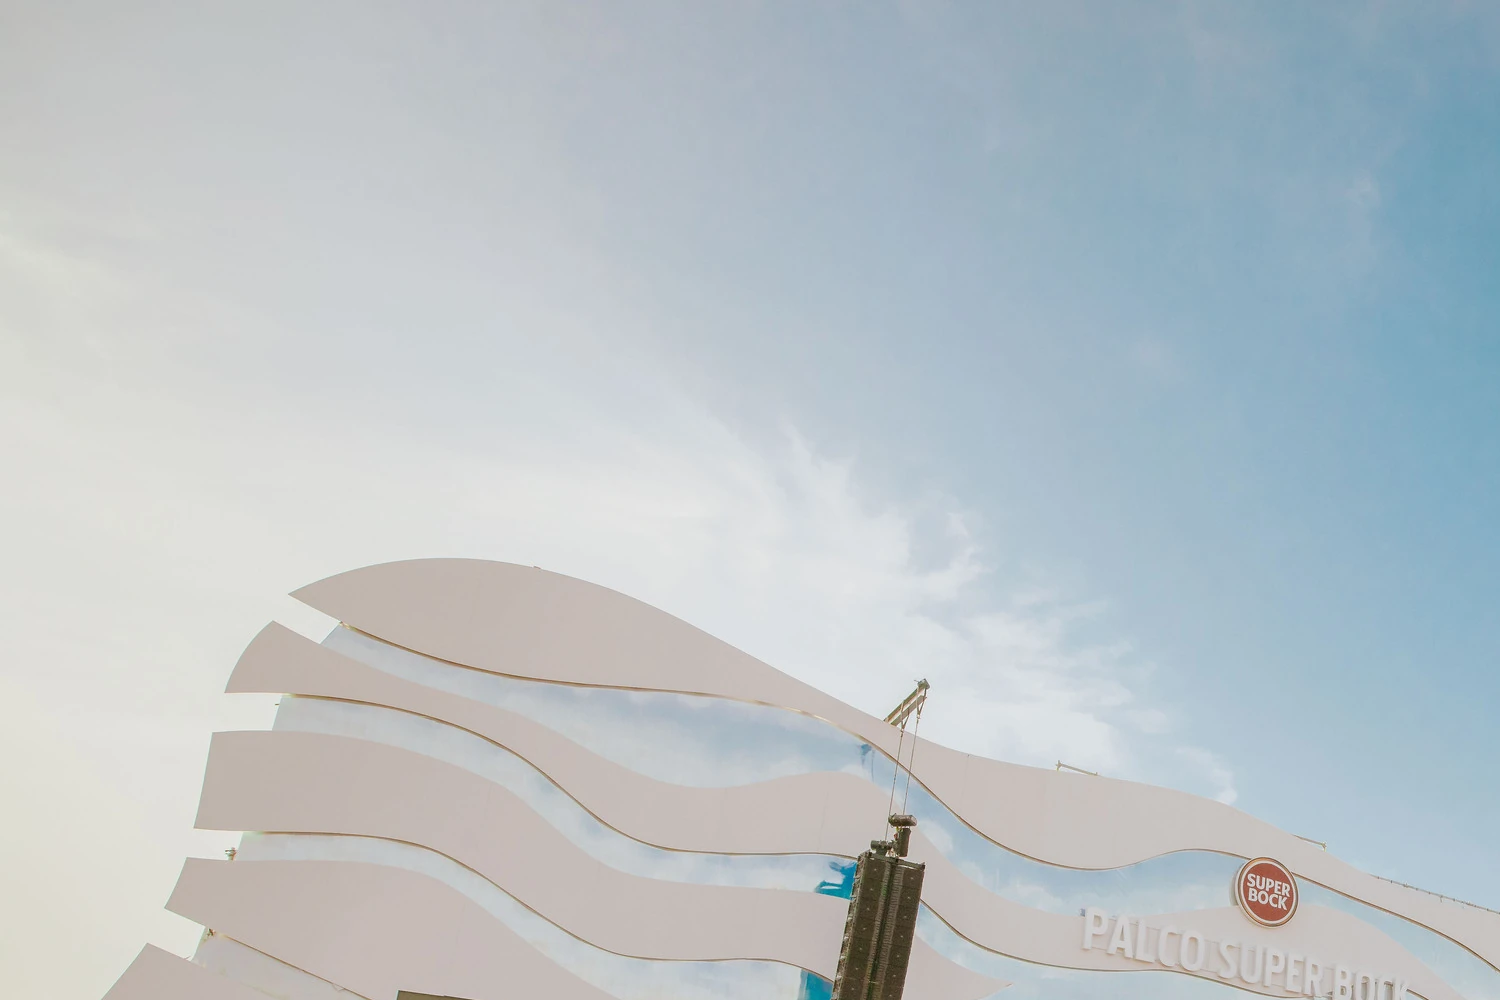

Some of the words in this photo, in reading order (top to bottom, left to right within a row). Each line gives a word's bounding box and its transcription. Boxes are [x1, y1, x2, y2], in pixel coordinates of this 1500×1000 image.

[1247, 873, 1290, 897] SUPER
[1248, 887, 1287, 911] BOCK
[1082, 907, 1205, 972] PALCO
[1217, 939, 1325, 998] SUPER
